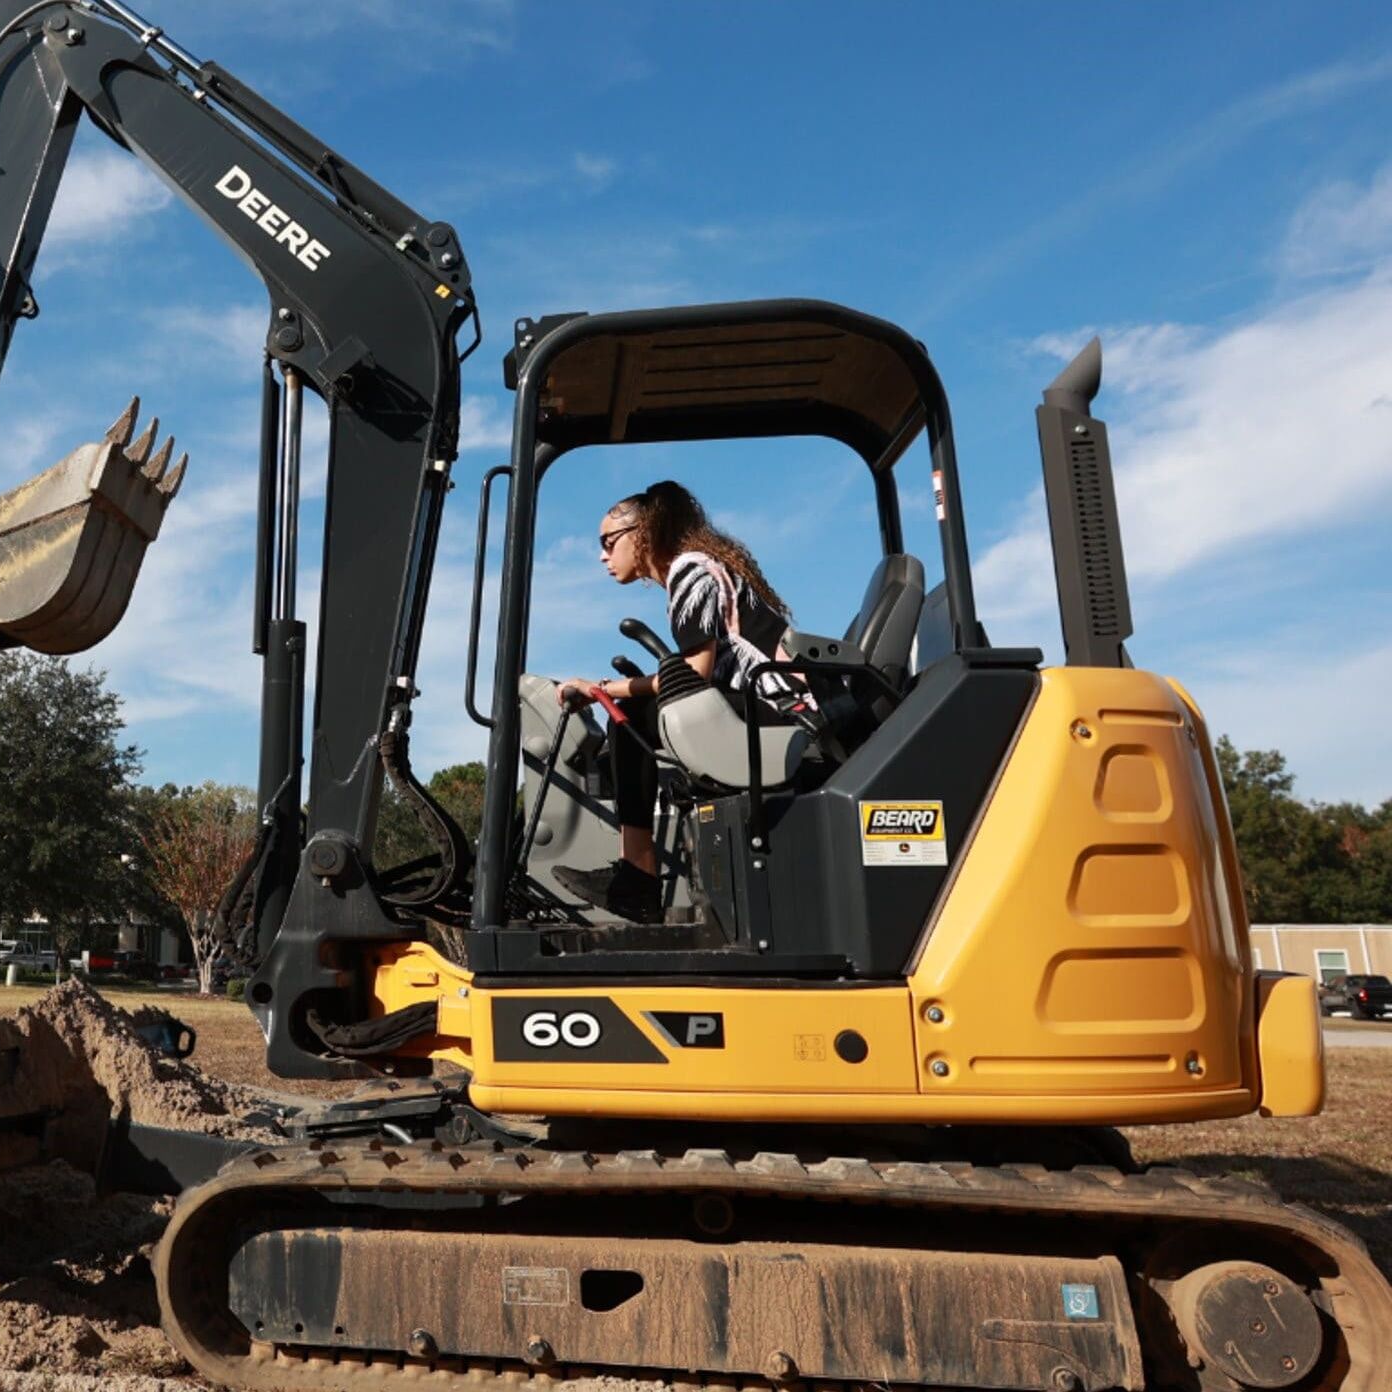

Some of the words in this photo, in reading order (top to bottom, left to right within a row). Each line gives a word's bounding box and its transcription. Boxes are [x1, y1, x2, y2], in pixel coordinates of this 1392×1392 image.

[215, 164, 331, 271] DEERE
[871, 810, 935, 833] BEARD
[523, 1012, 601, 1047] 60
[686, 1016, 717, 1044] P
